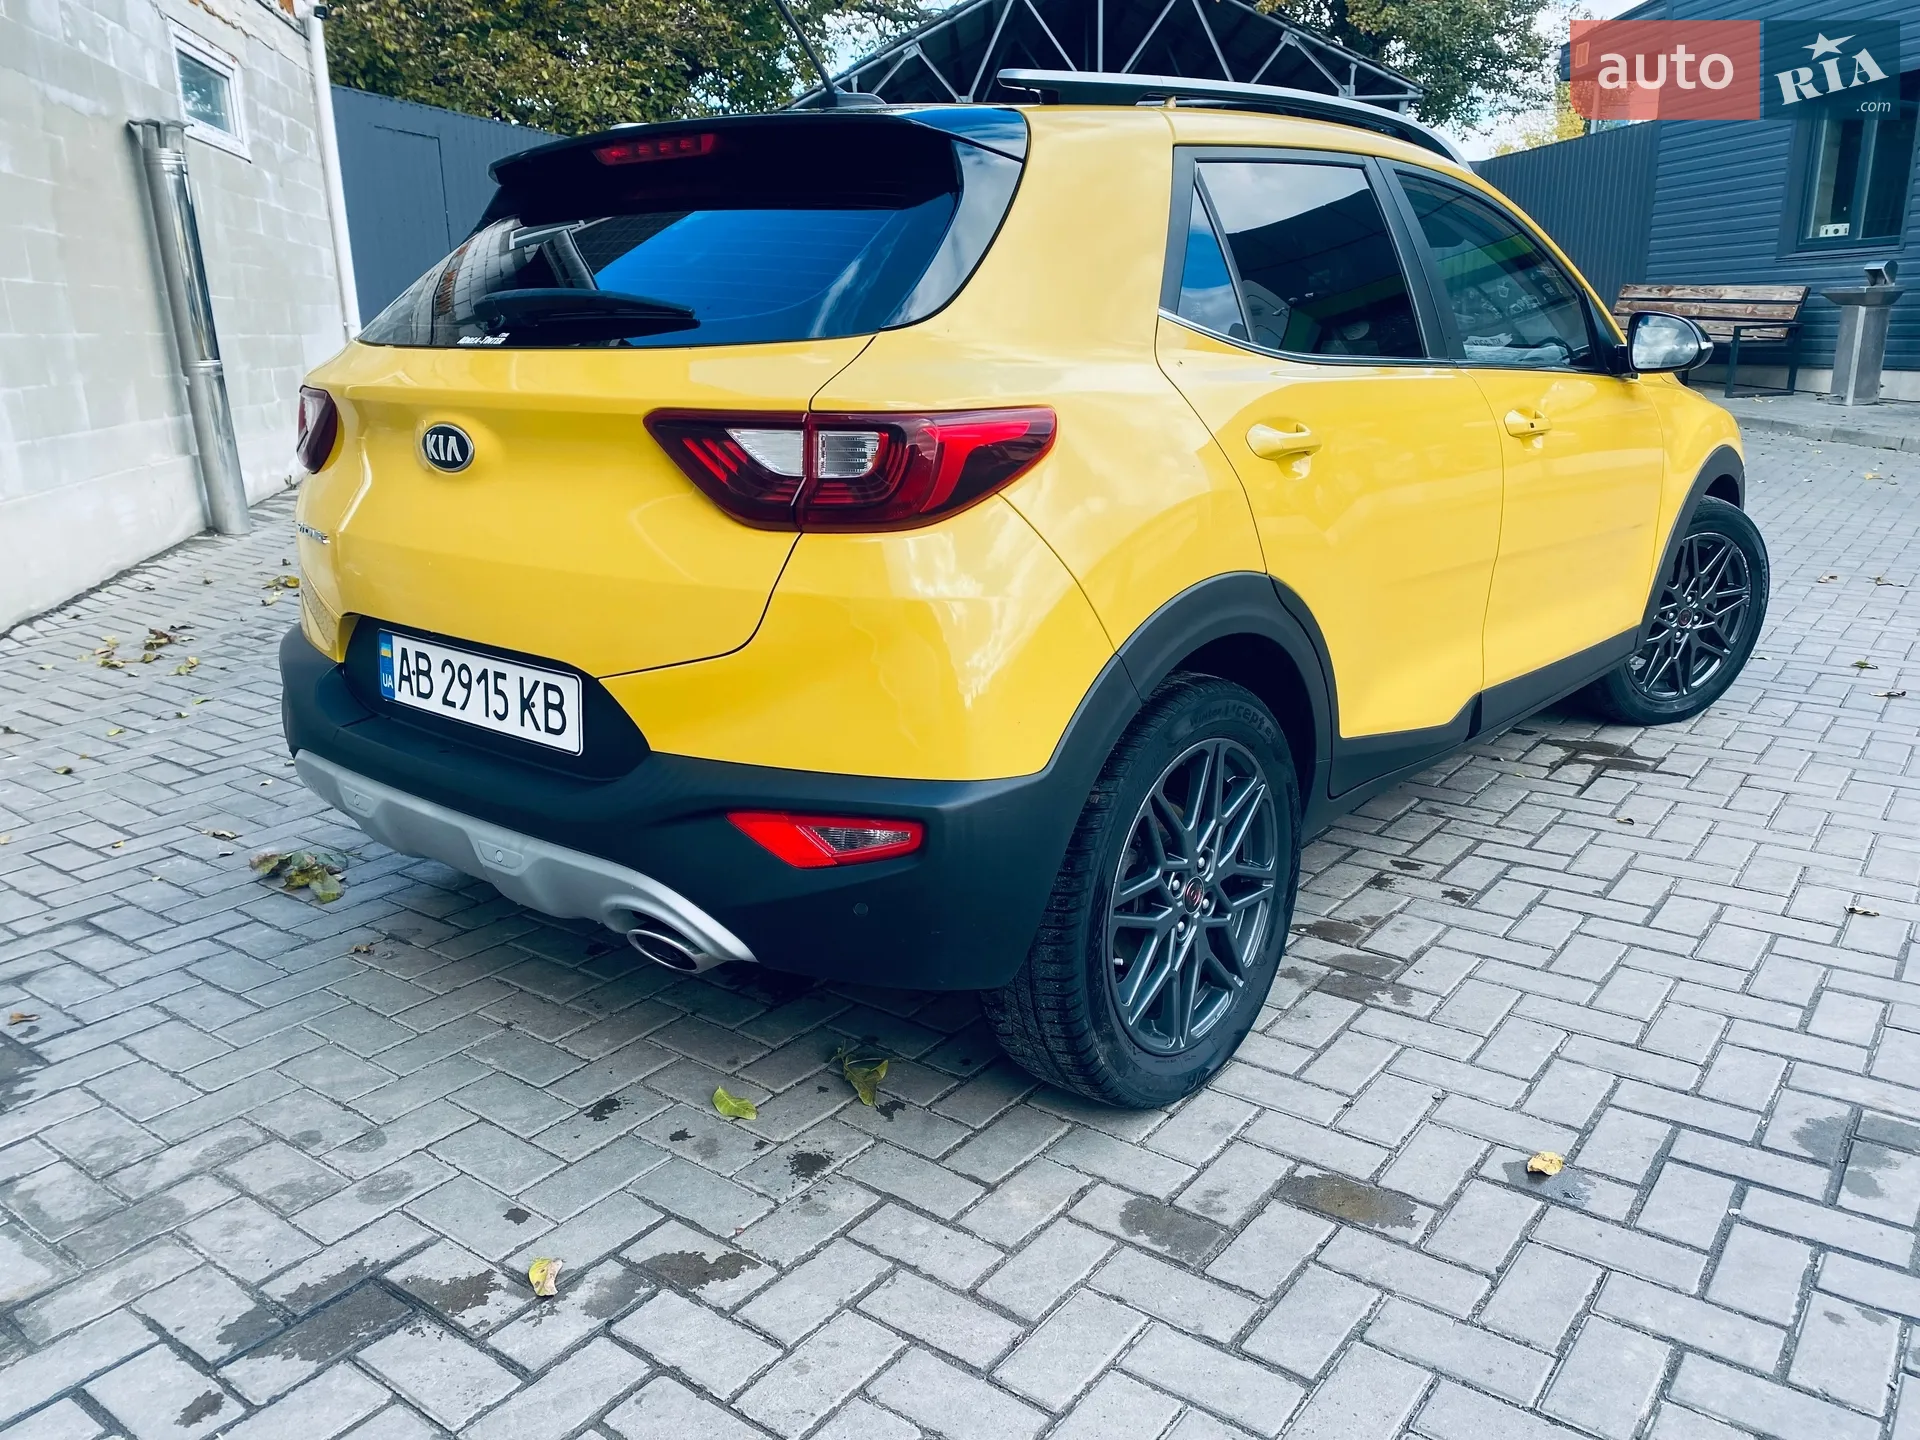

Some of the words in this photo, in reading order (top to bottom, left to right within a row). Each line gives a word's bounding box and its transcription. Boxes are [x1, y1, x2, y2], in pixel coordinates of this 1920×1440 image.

[426, 433, 463, 462] KIA
[382, 672, 394, 690] UA
[398, 647, 434, 700] AB
[440, 659, 509, 721] 2915
[519, 676, 567, 736] KB
